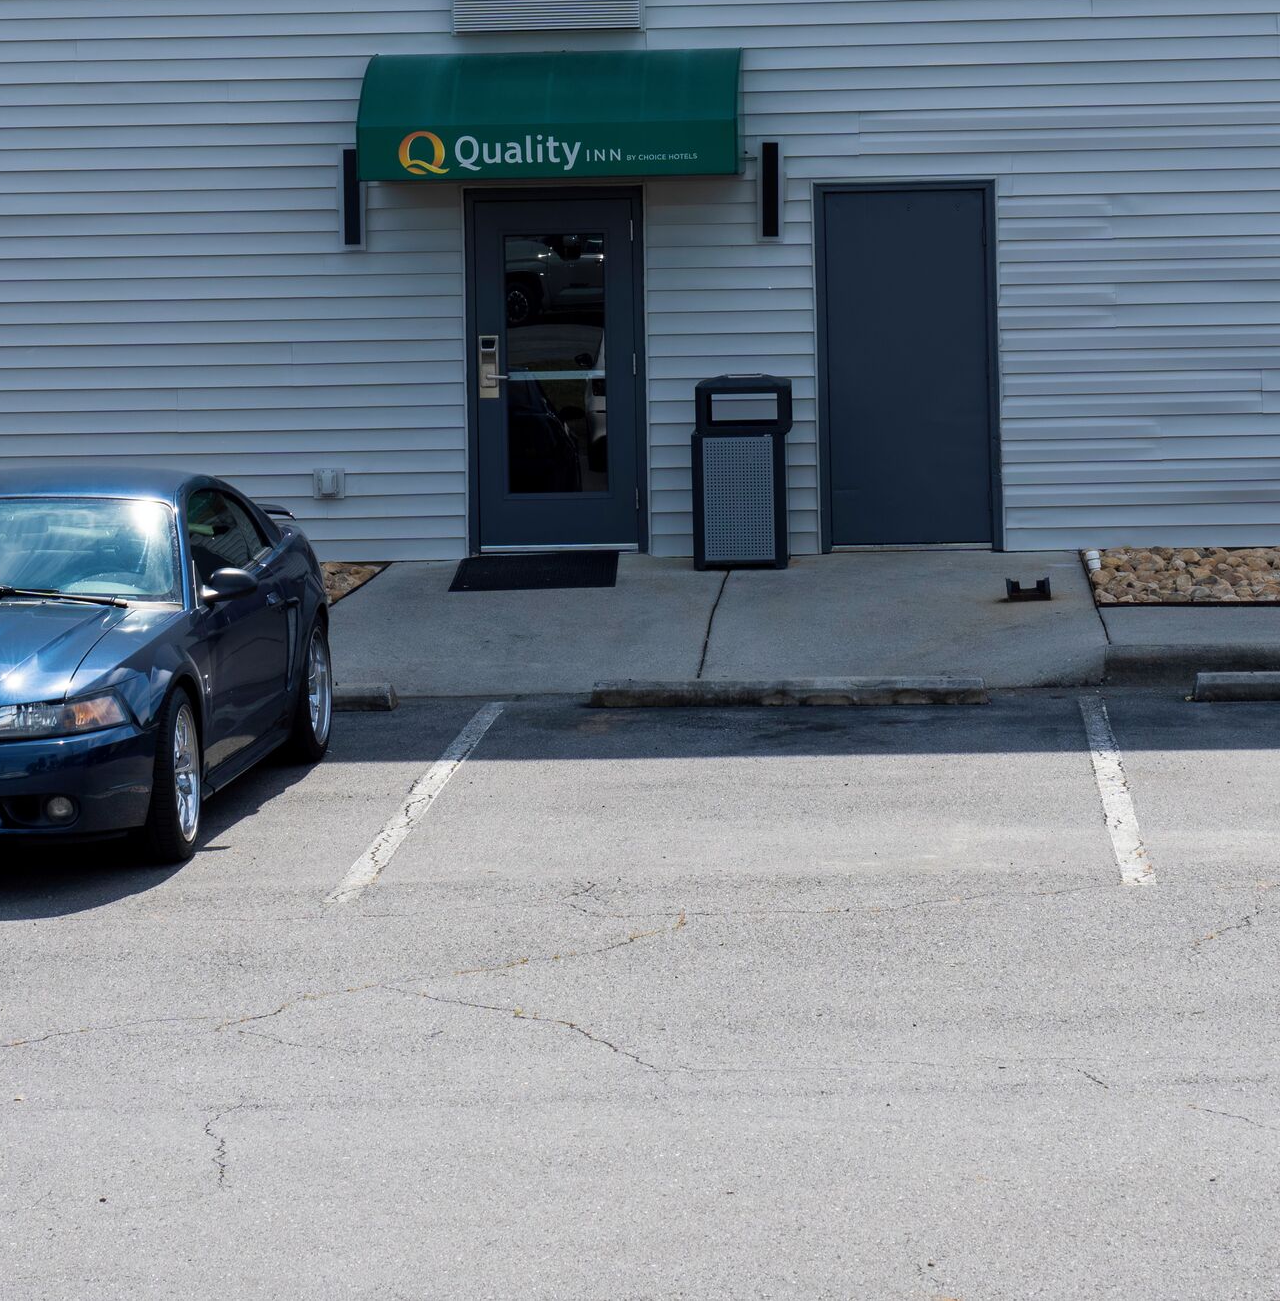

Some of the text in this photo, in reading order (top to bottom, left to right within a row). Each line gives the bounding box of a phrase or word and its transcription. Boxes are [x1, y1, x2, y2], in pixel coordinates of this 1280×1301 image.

[454, 134, 581, 171] Quality
[586, 148, 621, 162] INN
[638, 153, 666, 161] CHOICE
[668, 152, 698, 160] HOTELS
